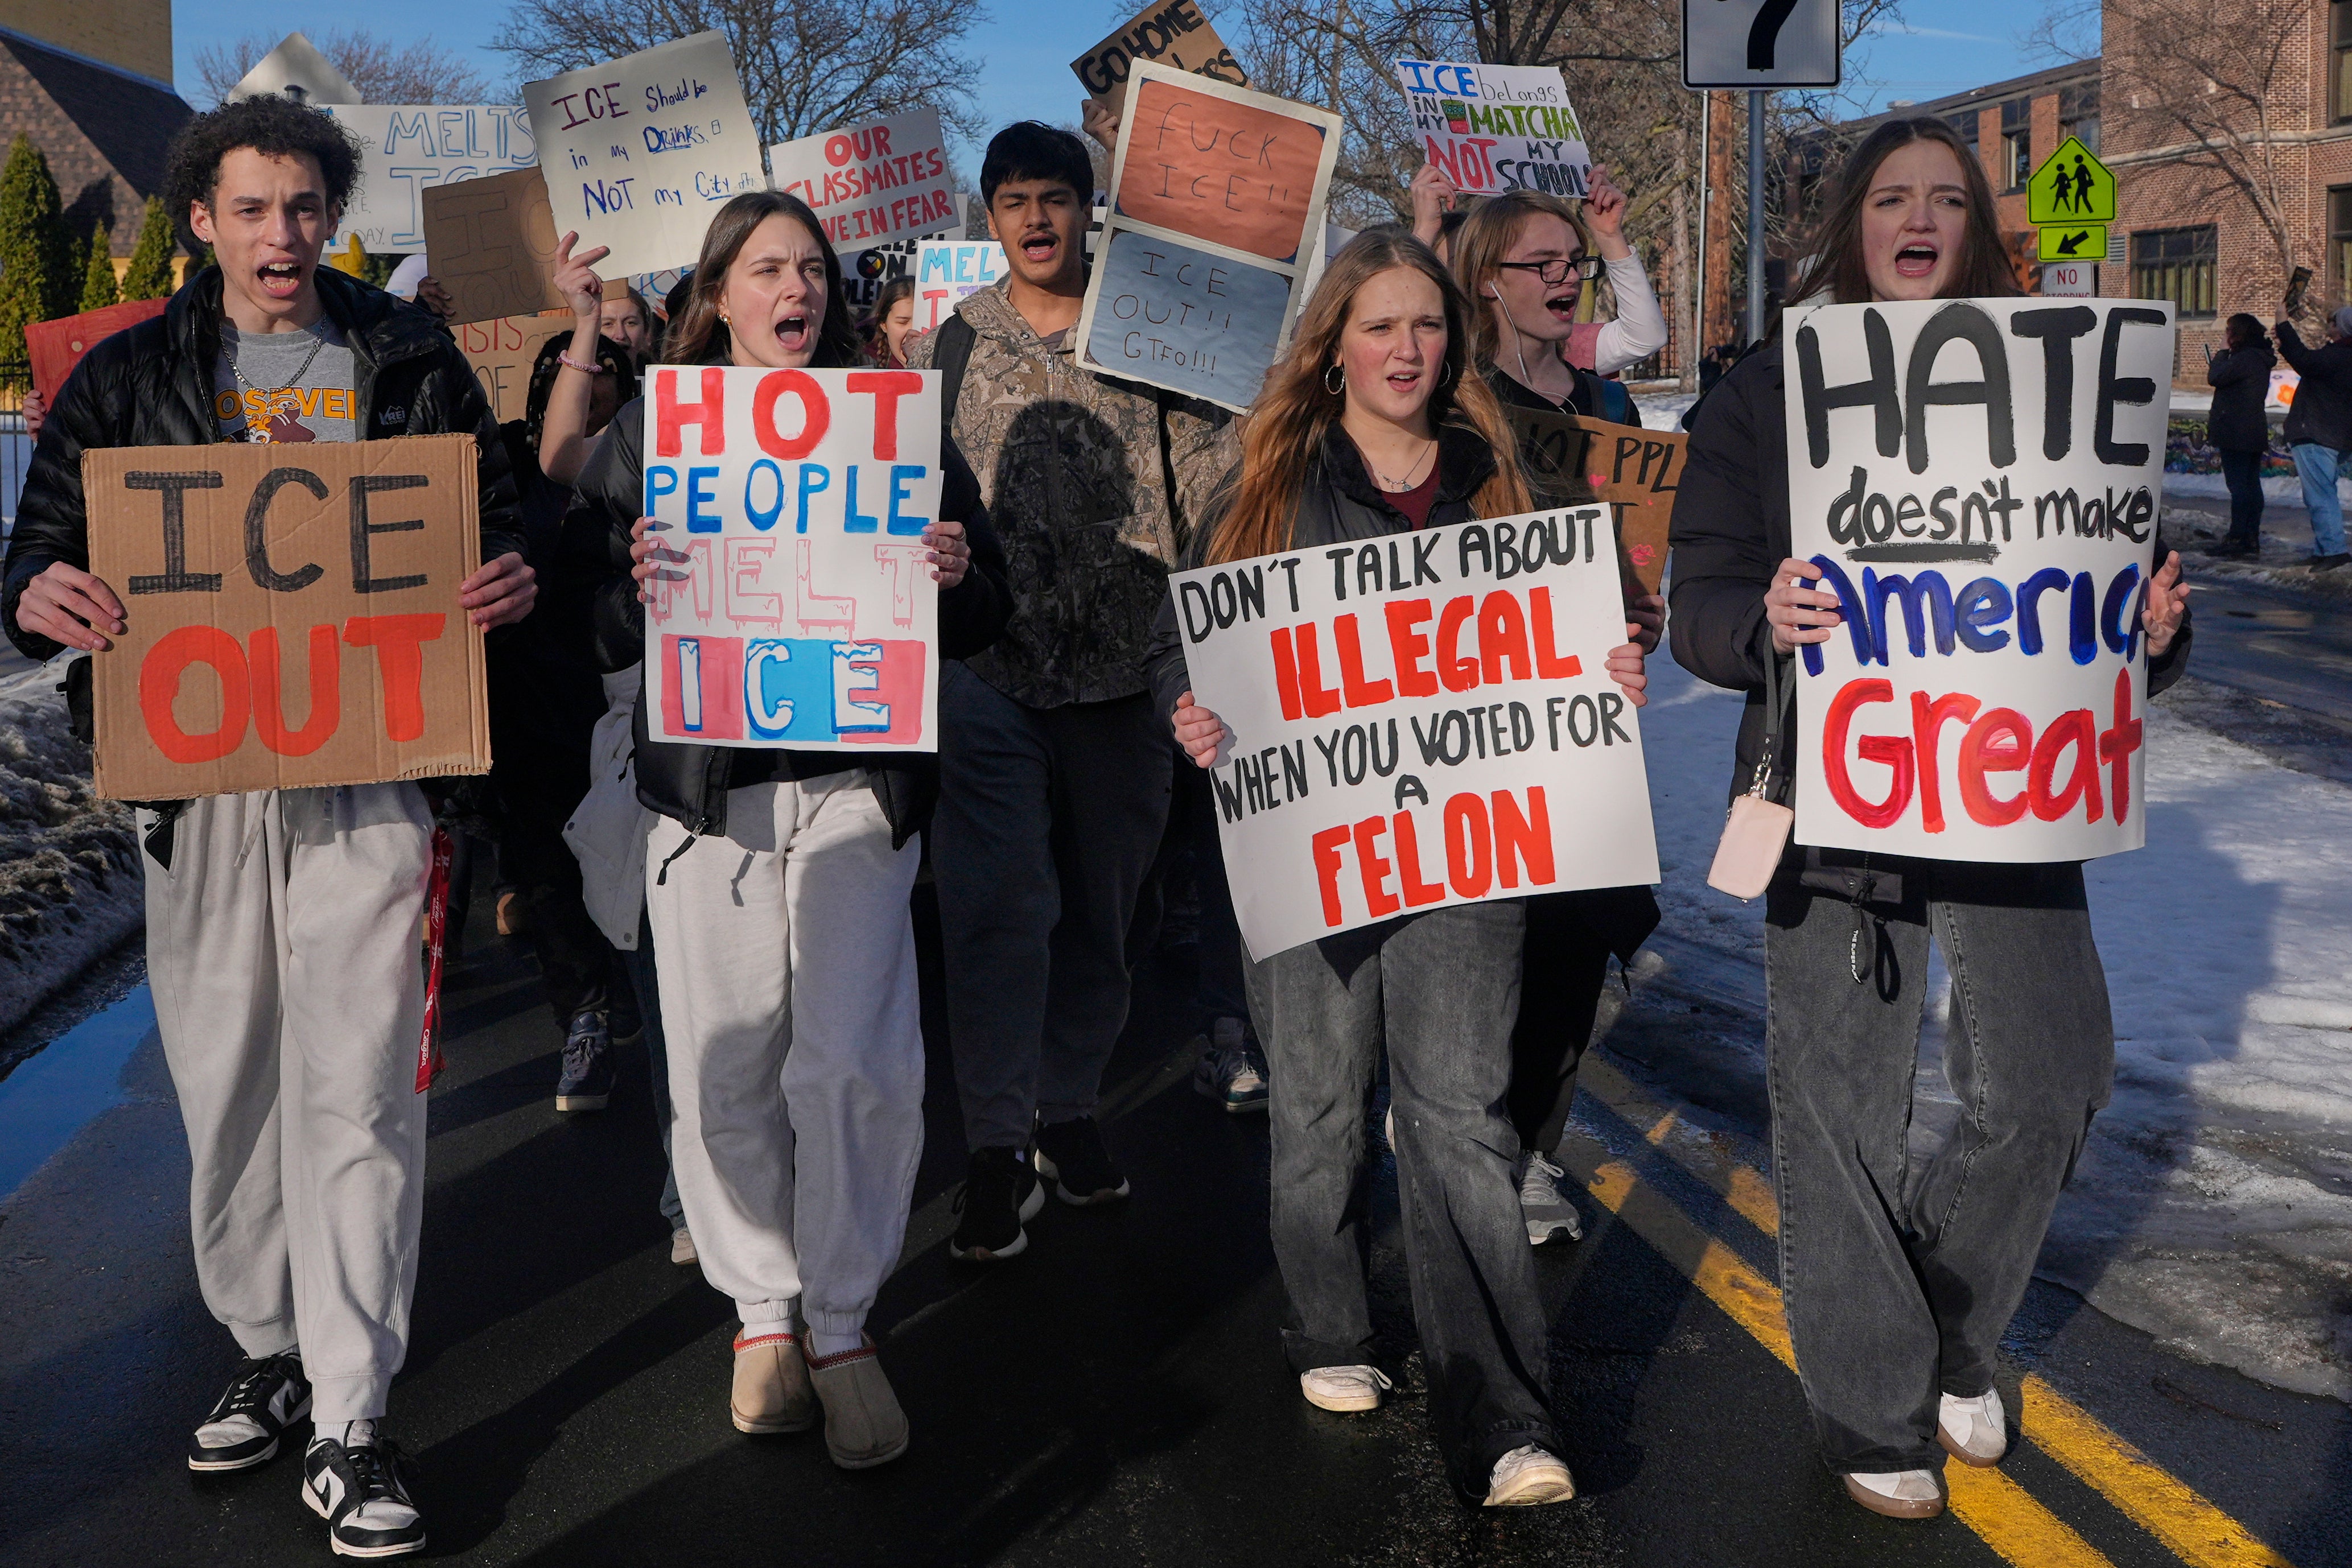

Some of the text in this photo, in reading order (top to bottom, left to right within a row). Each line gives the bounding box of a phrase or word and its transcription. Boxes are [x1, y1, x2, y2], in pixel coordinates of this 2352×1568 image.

[1080, 47, 1130, 94] GO
[1121, 0, 1204, 59] HOME
[550, 78, 708, 131] ICE Should be
[1399, 61, 1478, 98] ICE
[385, 107, 537, 165] MELTS
[825, 125, 892, 167] OUR
[1416, 104, 1582, 142] MY MATCHA
[569, 148, 588, 170] in
[1426, 135, 1564, 188] NOT MY
[820, 189, 953, 244] VE IN FEAR
[920, 246, 1006, 283] MEL
[957, 284, 986, 296] TH
[1140, 251, 1229, 298] ICE
[2057, 269, 2077, 284] NO
[1124, 331, 1216, 377] GTFO!!!
[656, 367, 924, 461] HOT
[1796, 300, 2167, 475] HATE
[1613, 436, 1678, 493] PPL
[645, 459, 930, 534] PEOPLE
[1826, 465, 2155, 548] doesn't make
[123, 467, 430, 595] ICE
[649, 536, 940, 633] MELT
[1180, 558, 1301, 644] DON'T
[1326, 533, 1441, 601] TALK
[1459, 509, 1601, 580] ABOUT
[1270, 585, 1583, 722] ILLEGAL
[138, 613, 447, 764] OUT
[677, 636, 891, 739] ICE
[1210, 692, 1632, 825] WHEN YOU VOTED FOR
[1822, 667, 2143, 833] Great
[1394, 774, 1429, 810] A
[1312, 786, 1556, 928] FELON
